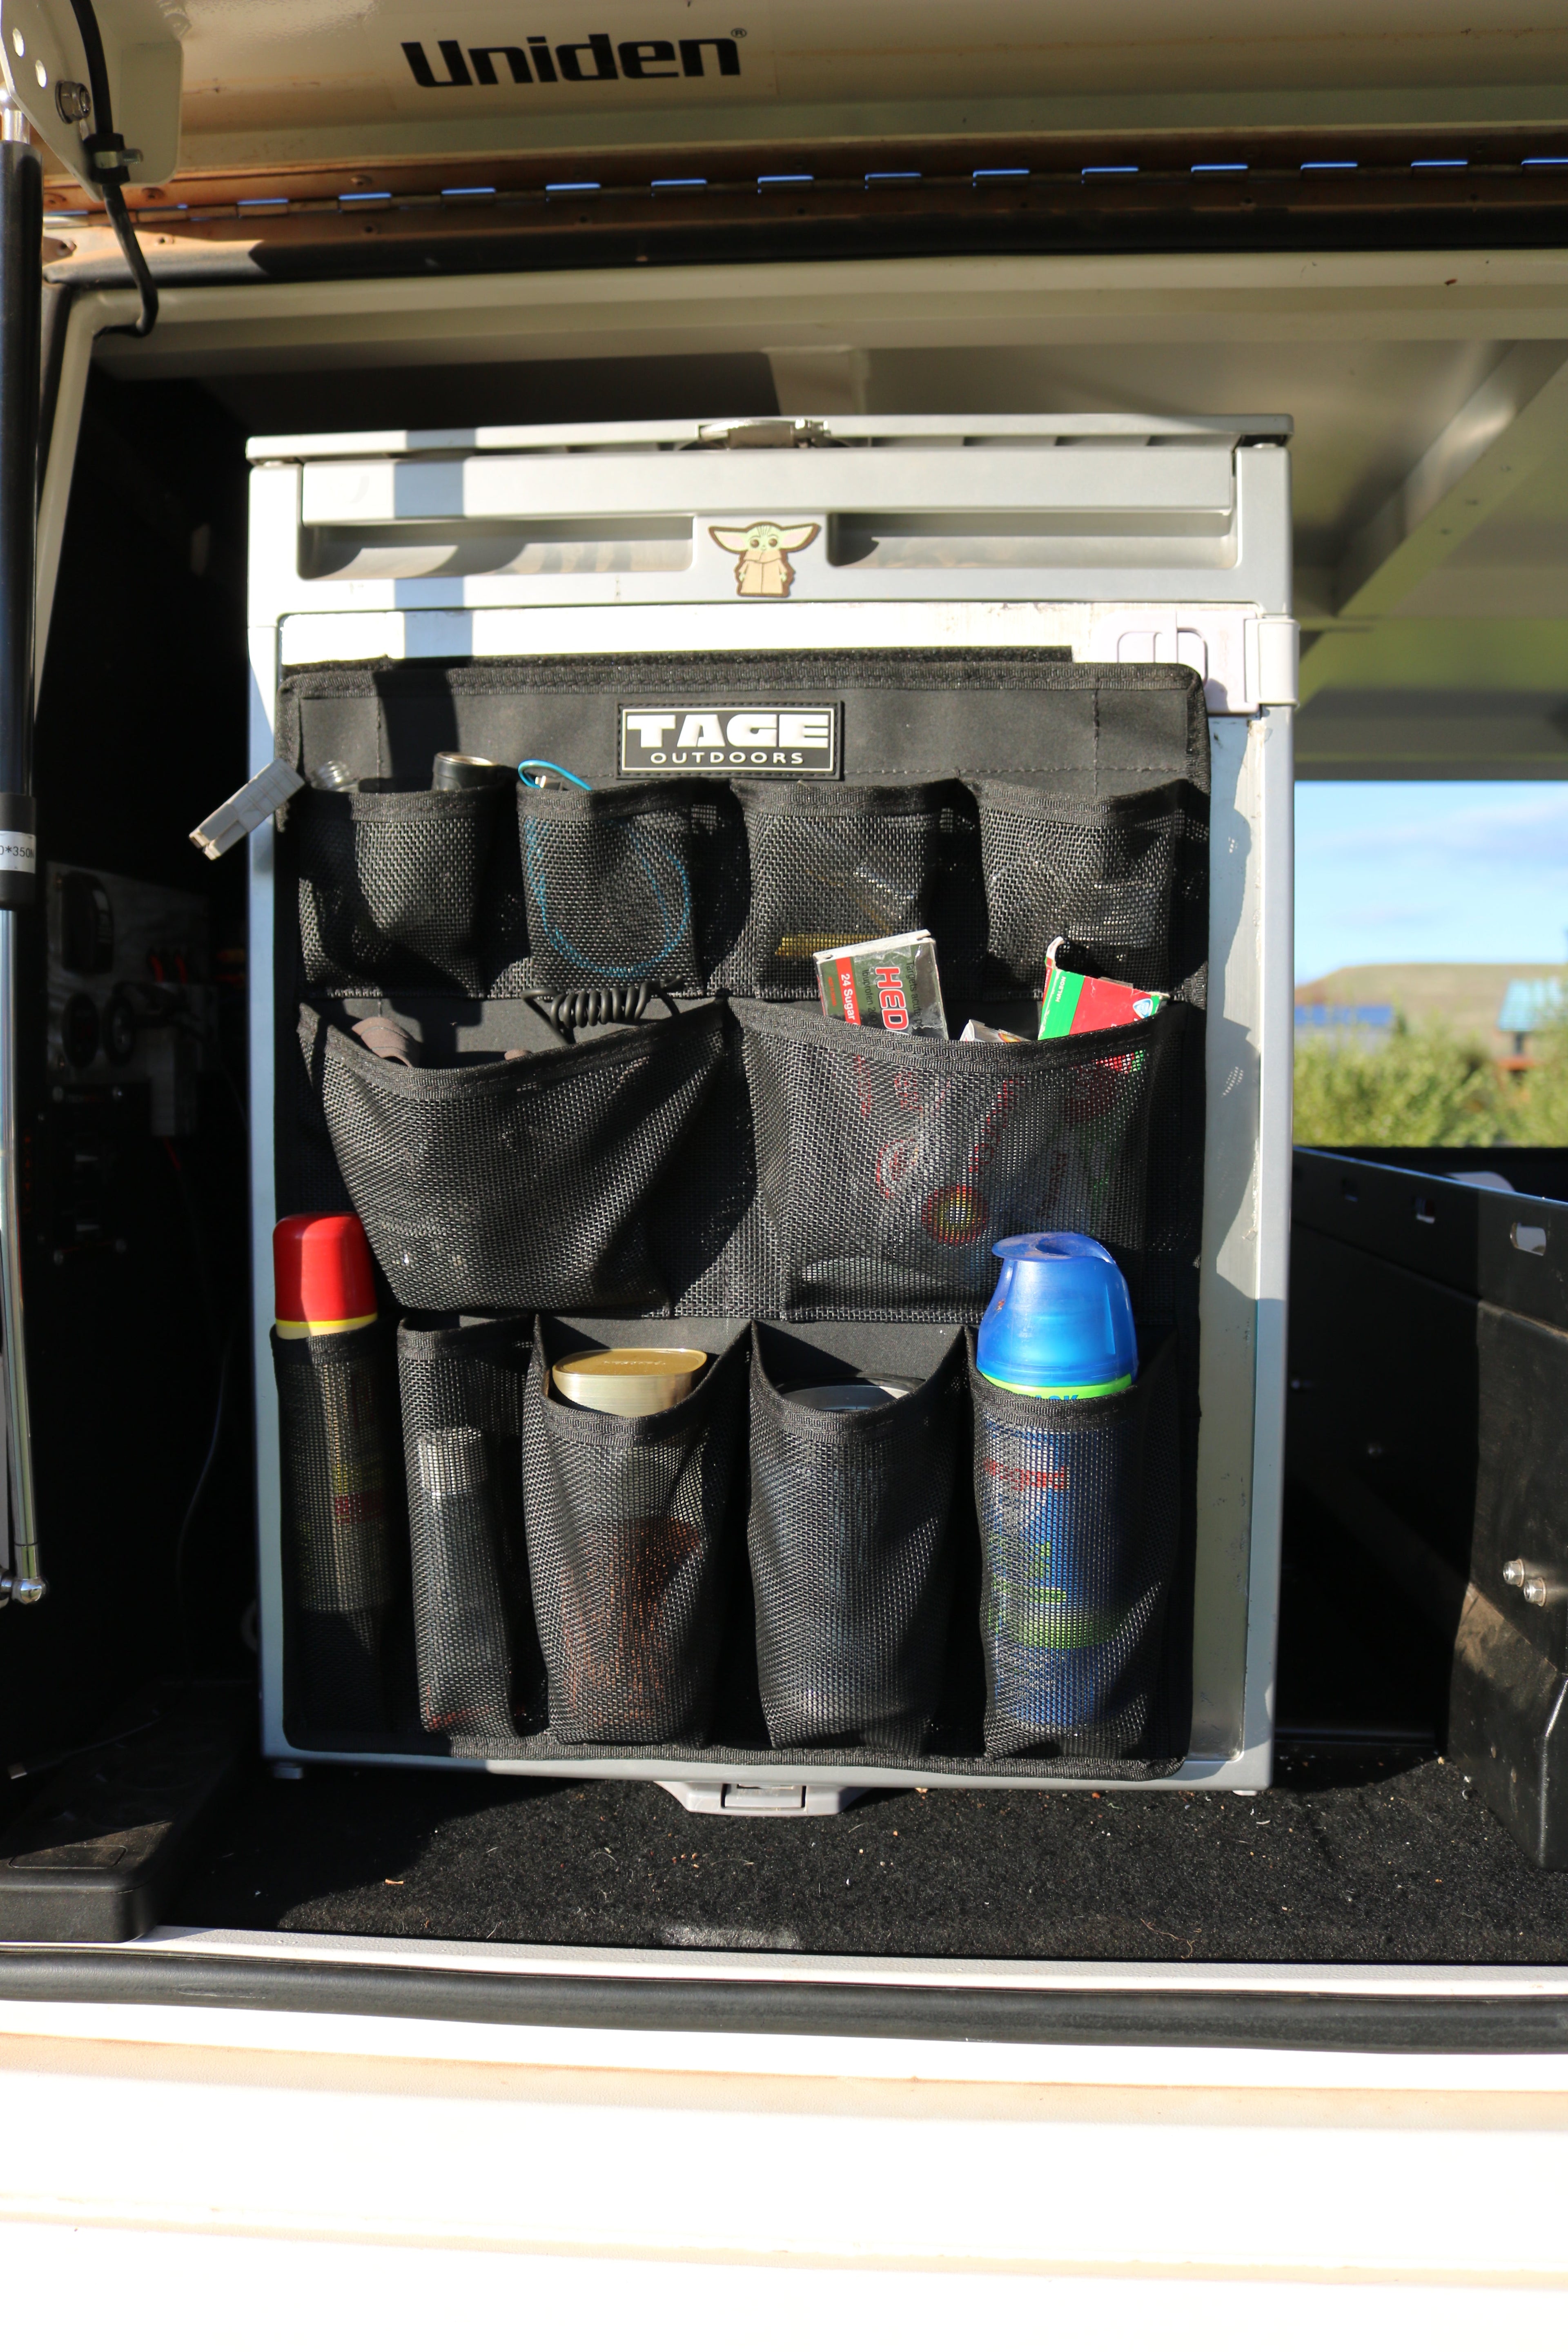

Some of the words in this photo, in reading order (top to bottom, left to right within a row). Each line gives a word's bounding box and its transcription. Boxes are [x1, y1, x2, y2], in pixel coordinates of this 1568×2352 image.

[401, 33, 741, 87] Uniden
[627, 714, 829, 748] TAGE
[650, 752, 804, 764] OUTDOORS
[841, 973, 852, 987] 24
[862, 969, 874, 1004] Ibuprofen
[906, 961, 918, 992] Targets
[1055, 976, 1067, 1003] HALEON
[843, 989, 856, 1020] Sugar
[875, 967, 910, 1035] HED
[911, 993, 922, 1017] acute
